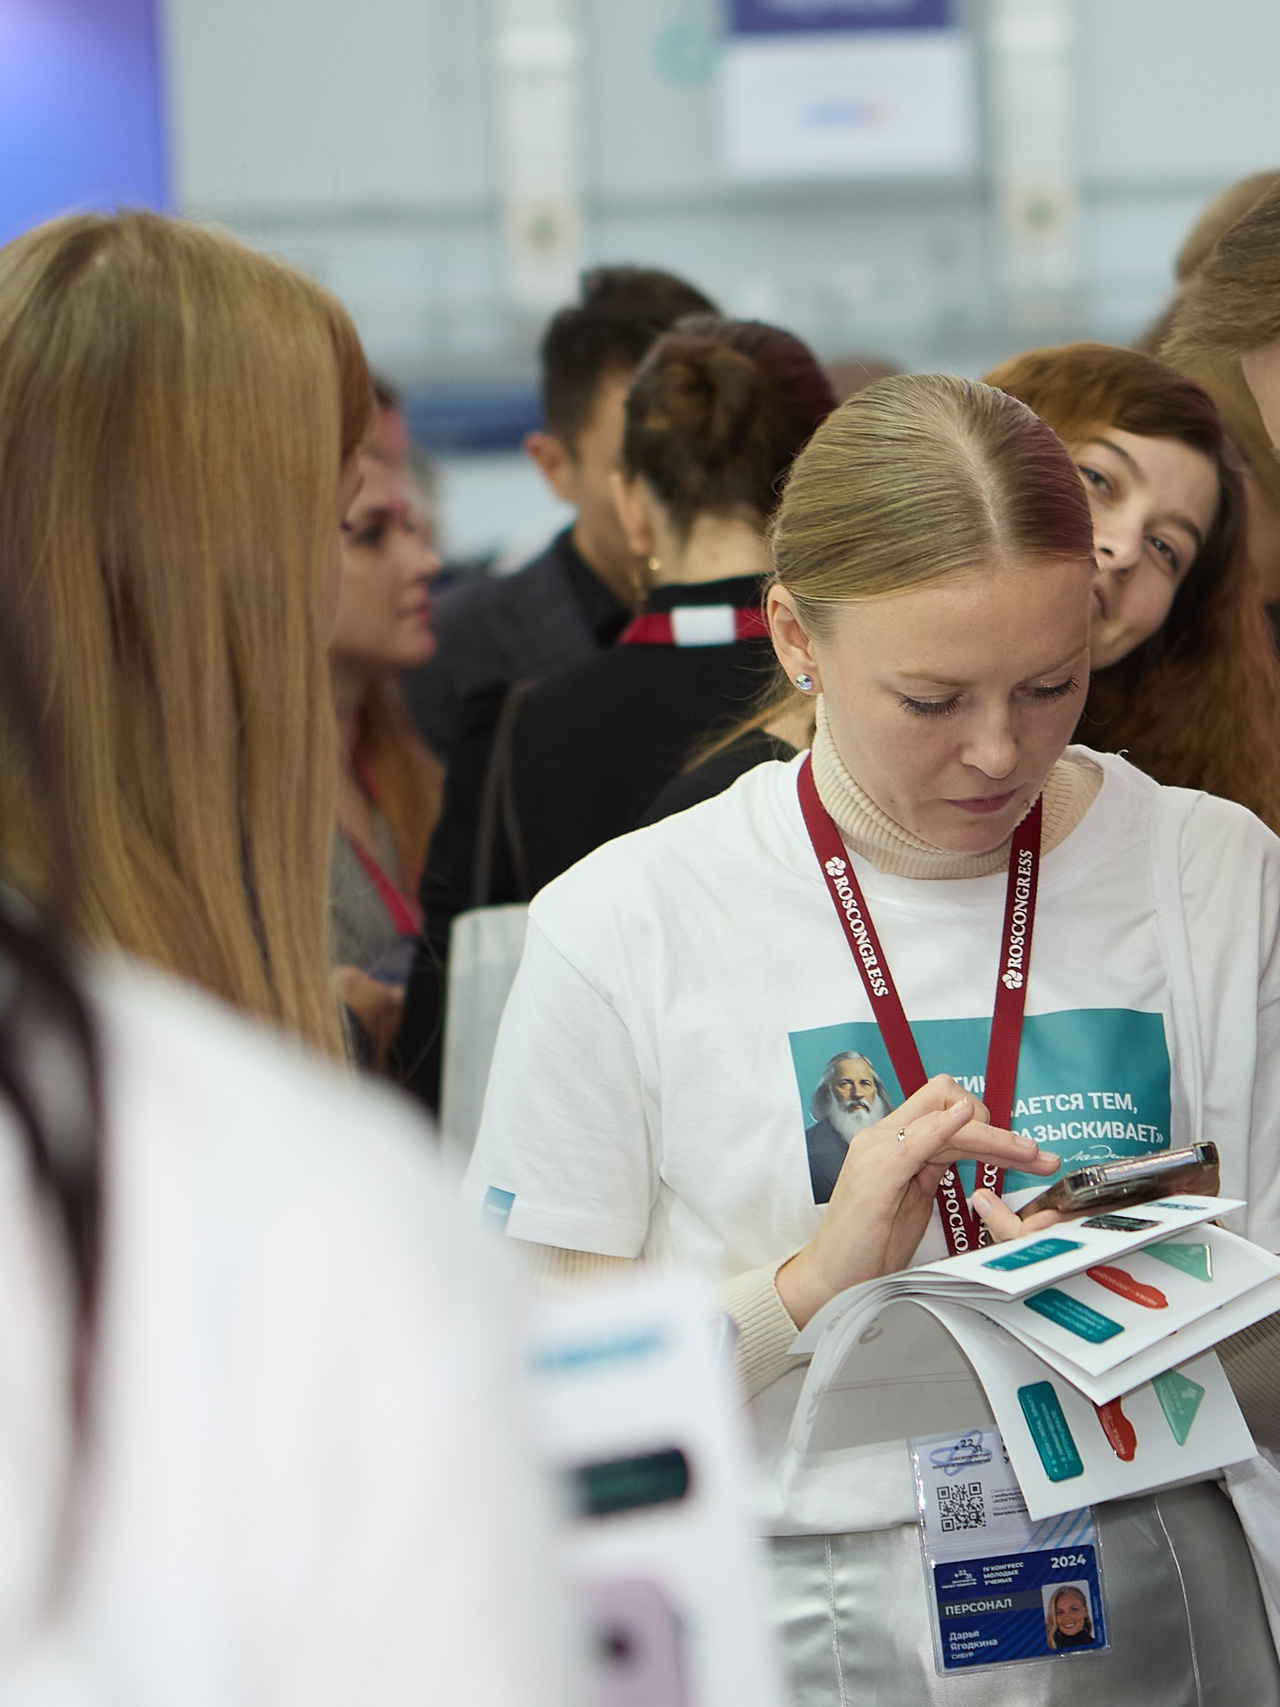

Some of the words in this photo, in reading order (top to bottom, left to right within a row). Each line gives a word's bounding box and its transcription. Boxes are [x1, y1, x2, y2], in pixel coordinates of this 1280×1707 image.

[1008, 849, 1033, 969] ROSCONGRESS
[833, 875, 888, 996] ROSCONGRESS
[1010, 1092, 1084, 1118] АЕТСЯ
[1087, 1092, 1138, 1115] ТЕМ,
[1012, 1121, 1164, 1143] АЗЫСКИВАЕТ»
[990, 1562, 1025, 1571] КОНГРЕСС
[1051, 1553, 1087, 1569] 2024
[983, 1569, 1020, 1579] МОЛОДЫХ
[945, 1598, 1013, 1616] ПЕРСОНАЛ
[949, 1629, 980, 1642] Дарья
[950, 1638, 998, 1652] Ягодкина
